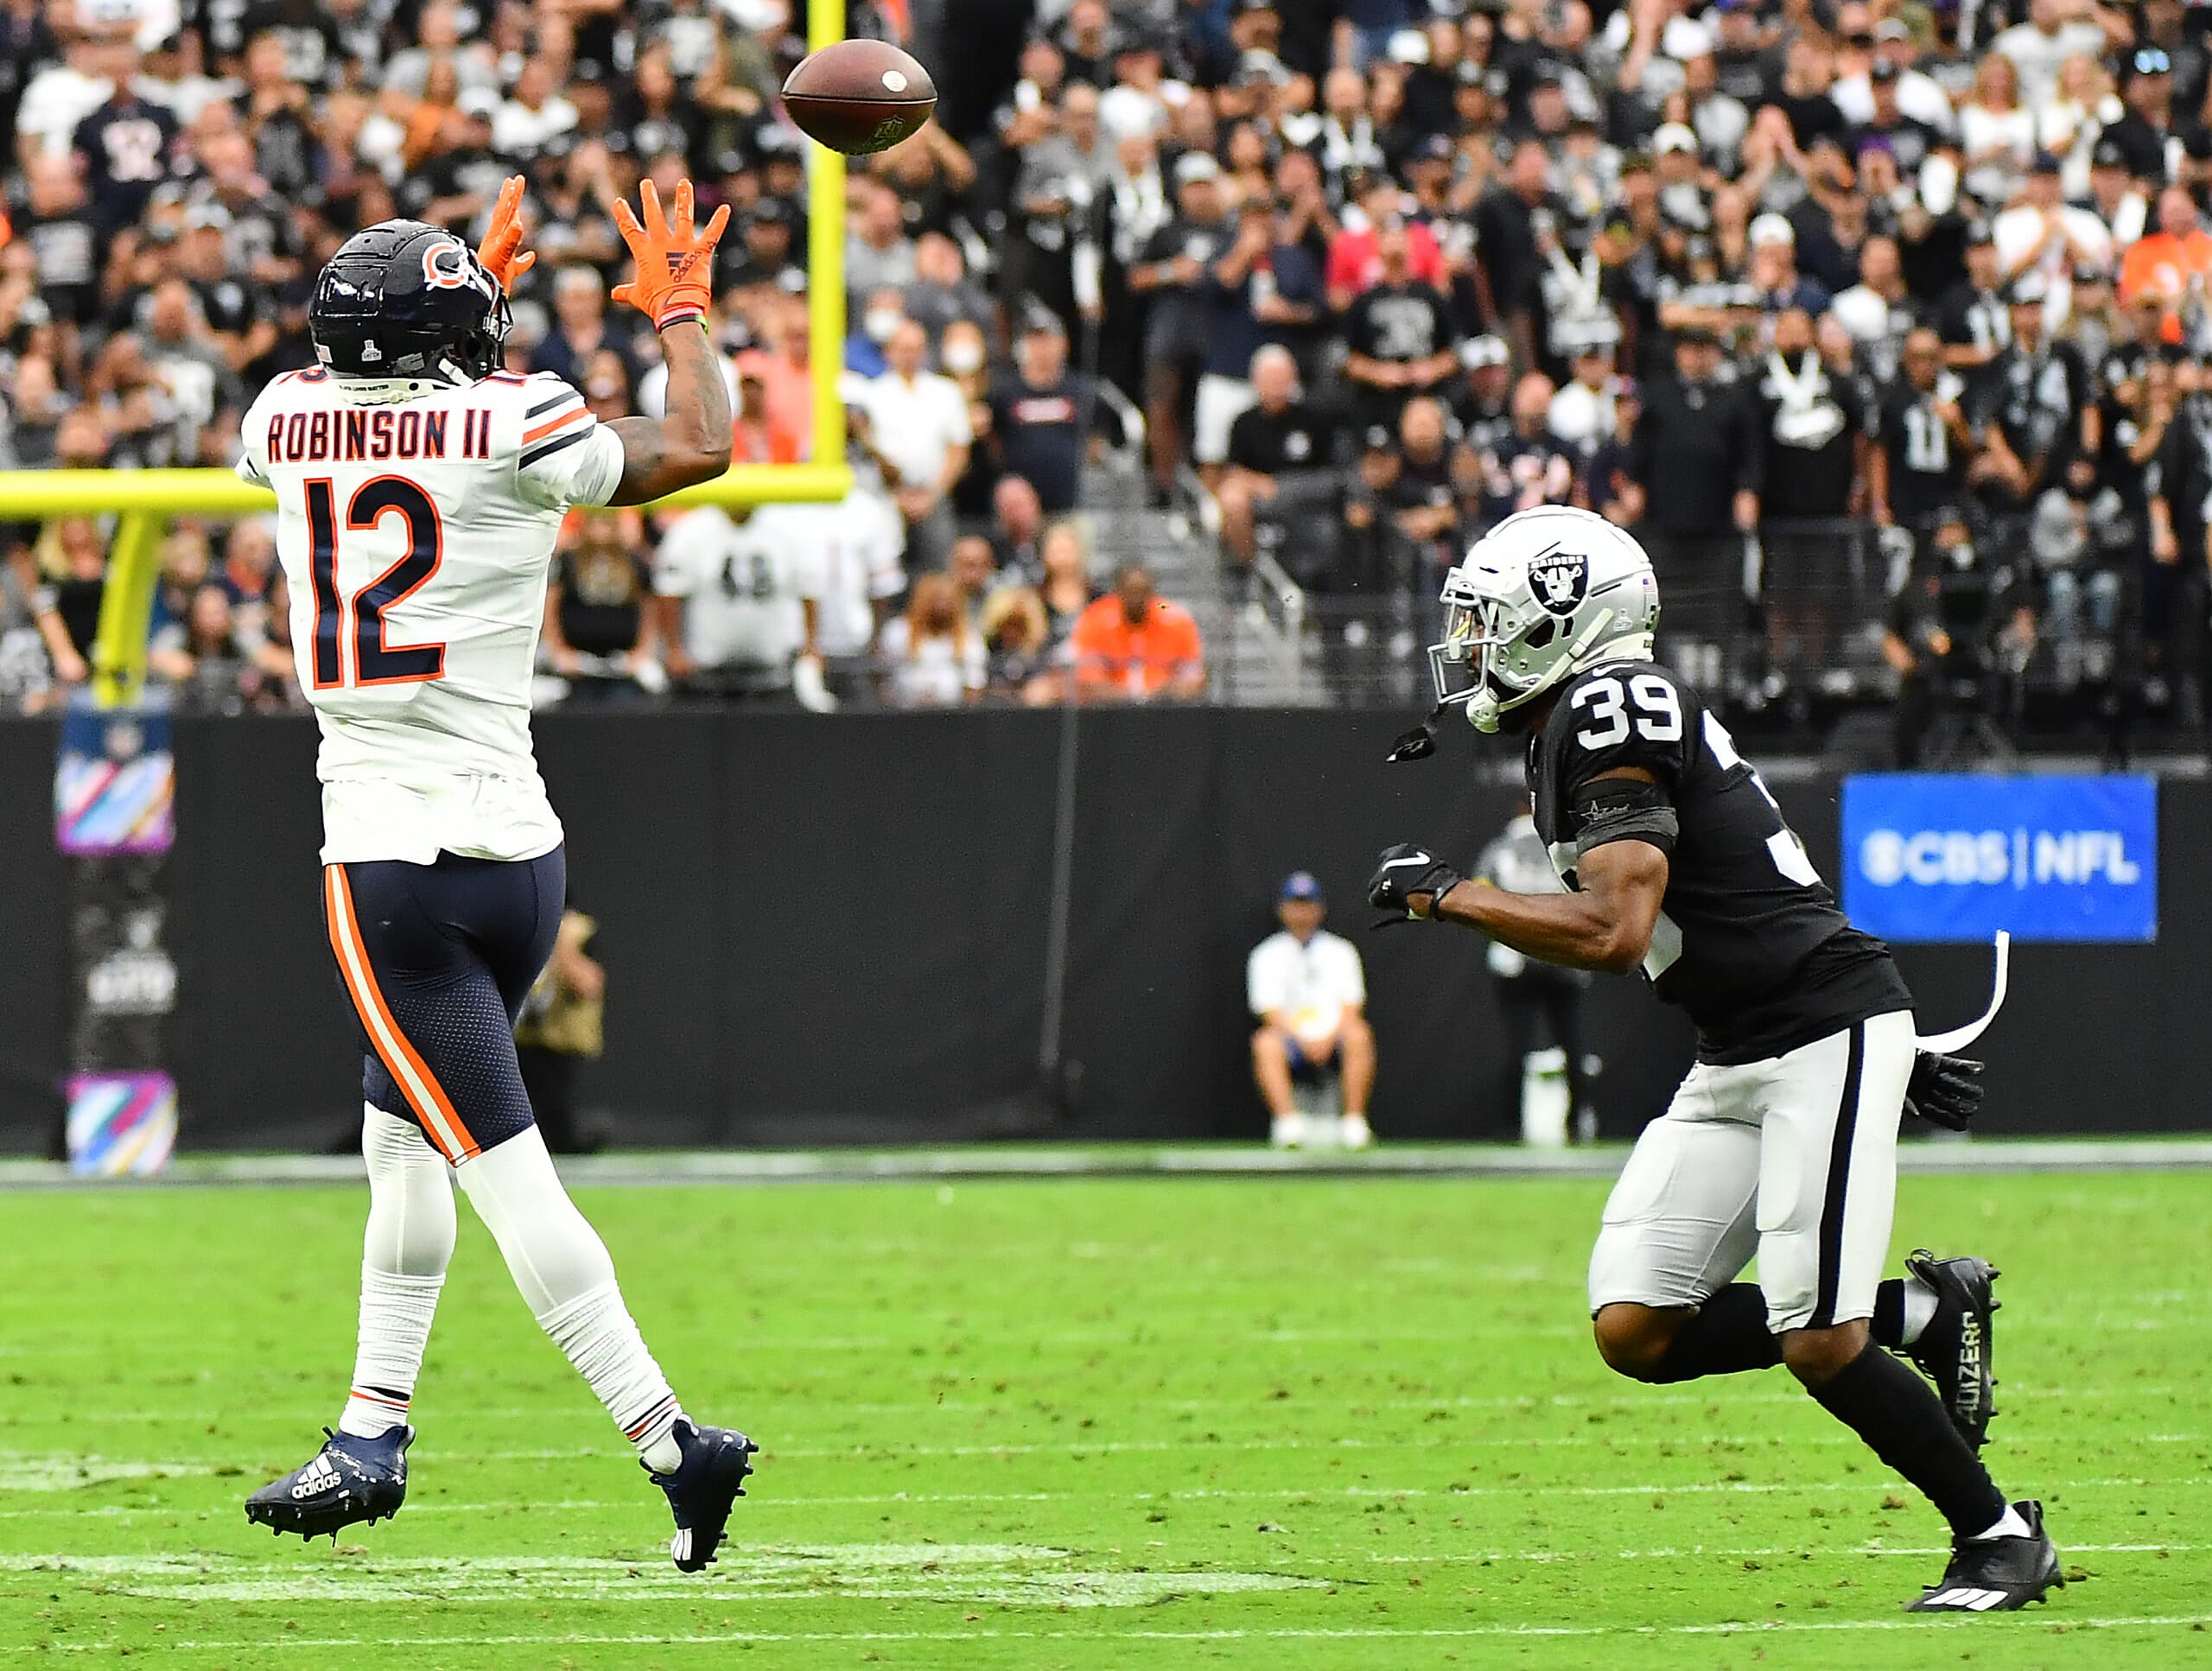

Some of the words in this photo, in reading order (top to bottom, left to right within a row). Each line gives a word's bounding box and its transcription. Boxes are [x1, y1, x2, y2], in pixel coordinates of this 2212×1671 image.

[268, 410, 449, 464] ROBINSON
[462, 409, 492, 460] II
[303, 473, 446, 690] 12
[1529, 555, 1585, 569] RAIDERS
[1571, 674, 1683, 751] 39
[1906, 830, 2009, 886] CBS
[2033, 830, 2140, 886] NFL
[291, 1471, 342, 1499] adidas
